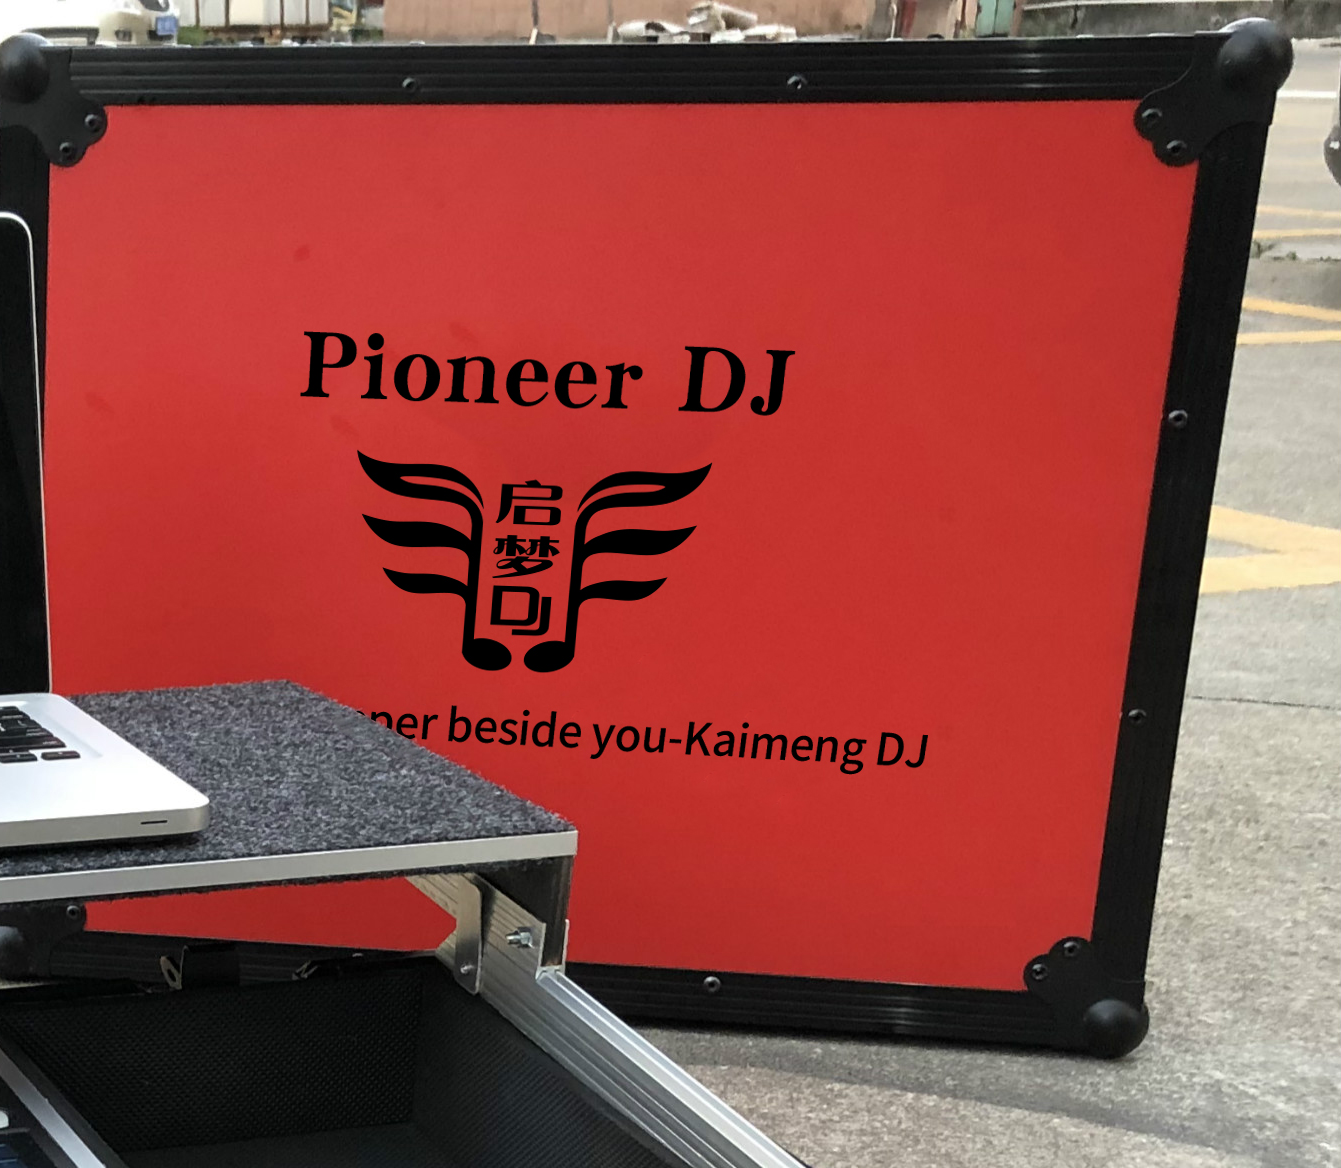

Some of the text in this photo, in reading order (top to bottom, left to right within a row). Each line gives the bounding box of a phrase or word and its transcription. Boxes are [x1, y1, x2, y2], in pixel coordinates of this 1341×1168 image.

[300, 331, 796, 416] Pioneer DJ
[448, 706, 582, 748] beside
[590, 721, 867, 775] you-Kaimeng
[877, 732, 929, 769] DJ
